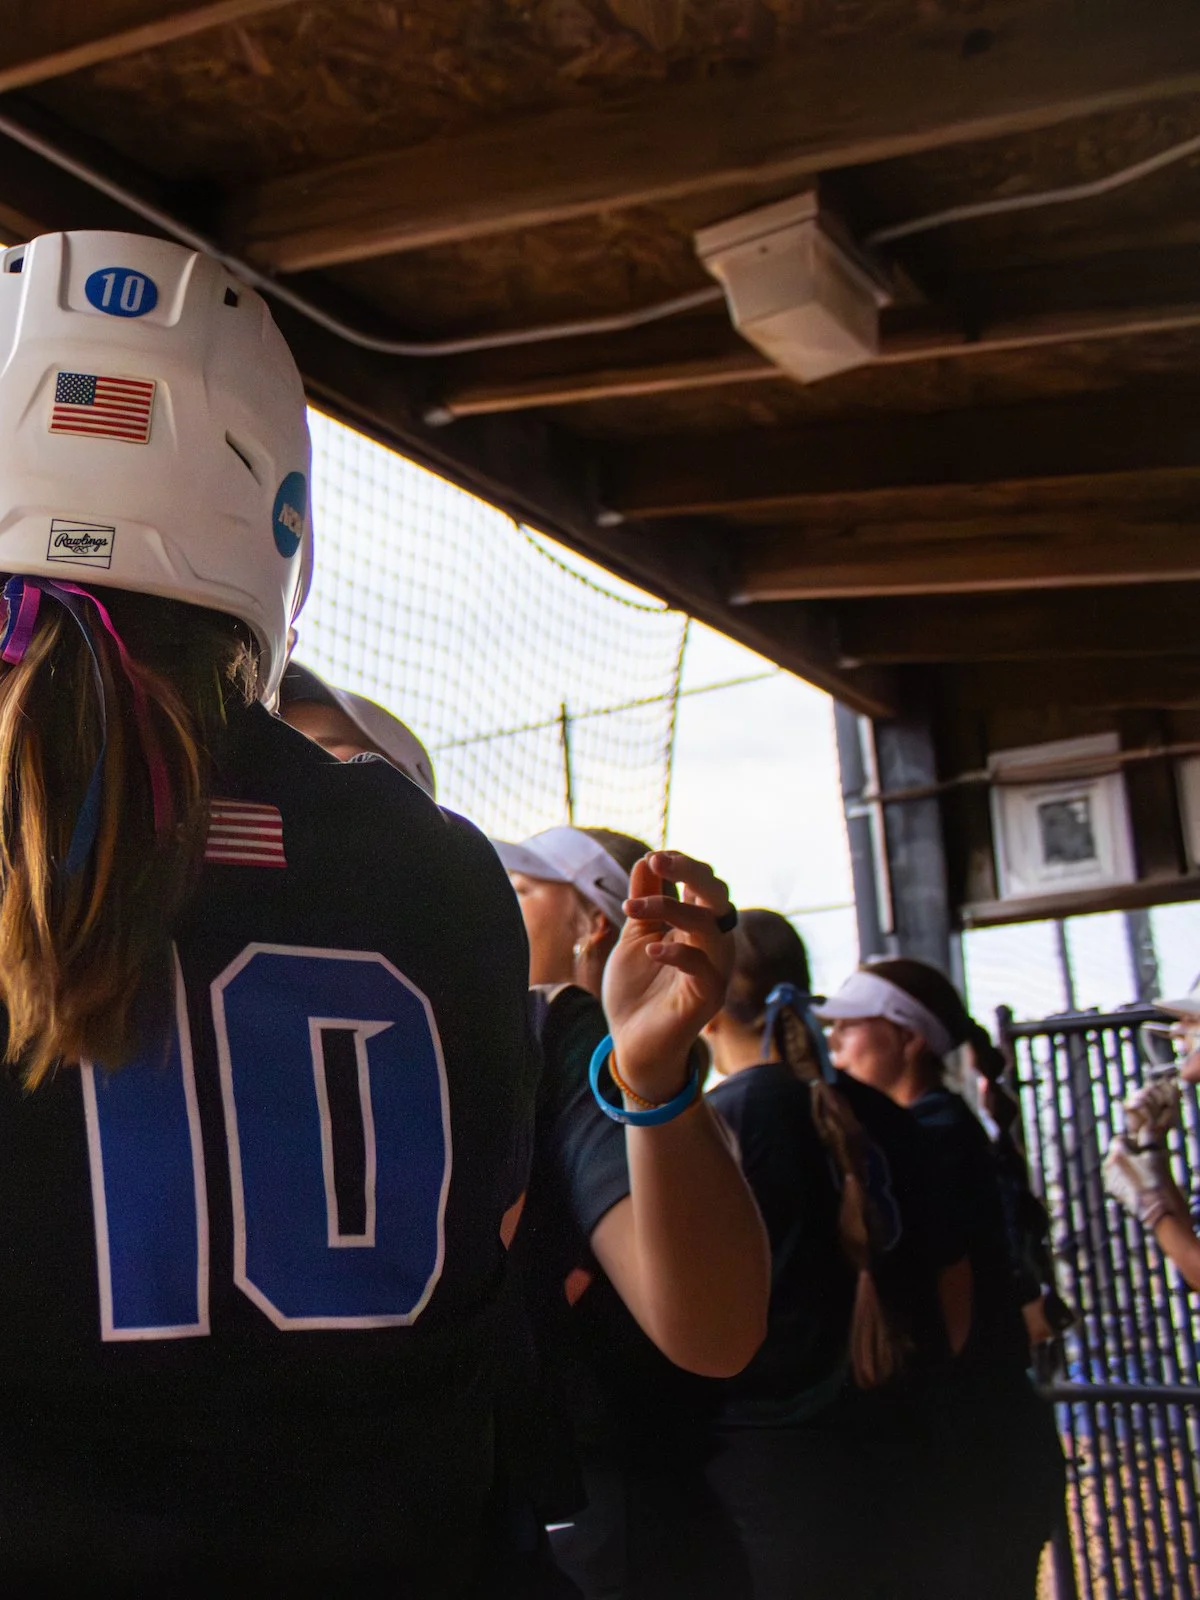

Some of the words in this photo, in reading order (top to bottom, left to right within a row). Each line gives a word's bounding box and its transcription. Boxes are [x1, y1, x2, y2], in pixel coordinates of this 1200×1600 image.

[102, 272, 145, 312] 10
[54, 532, 108, 552] Rawlings
[80, 940, 453, 1342] 10
